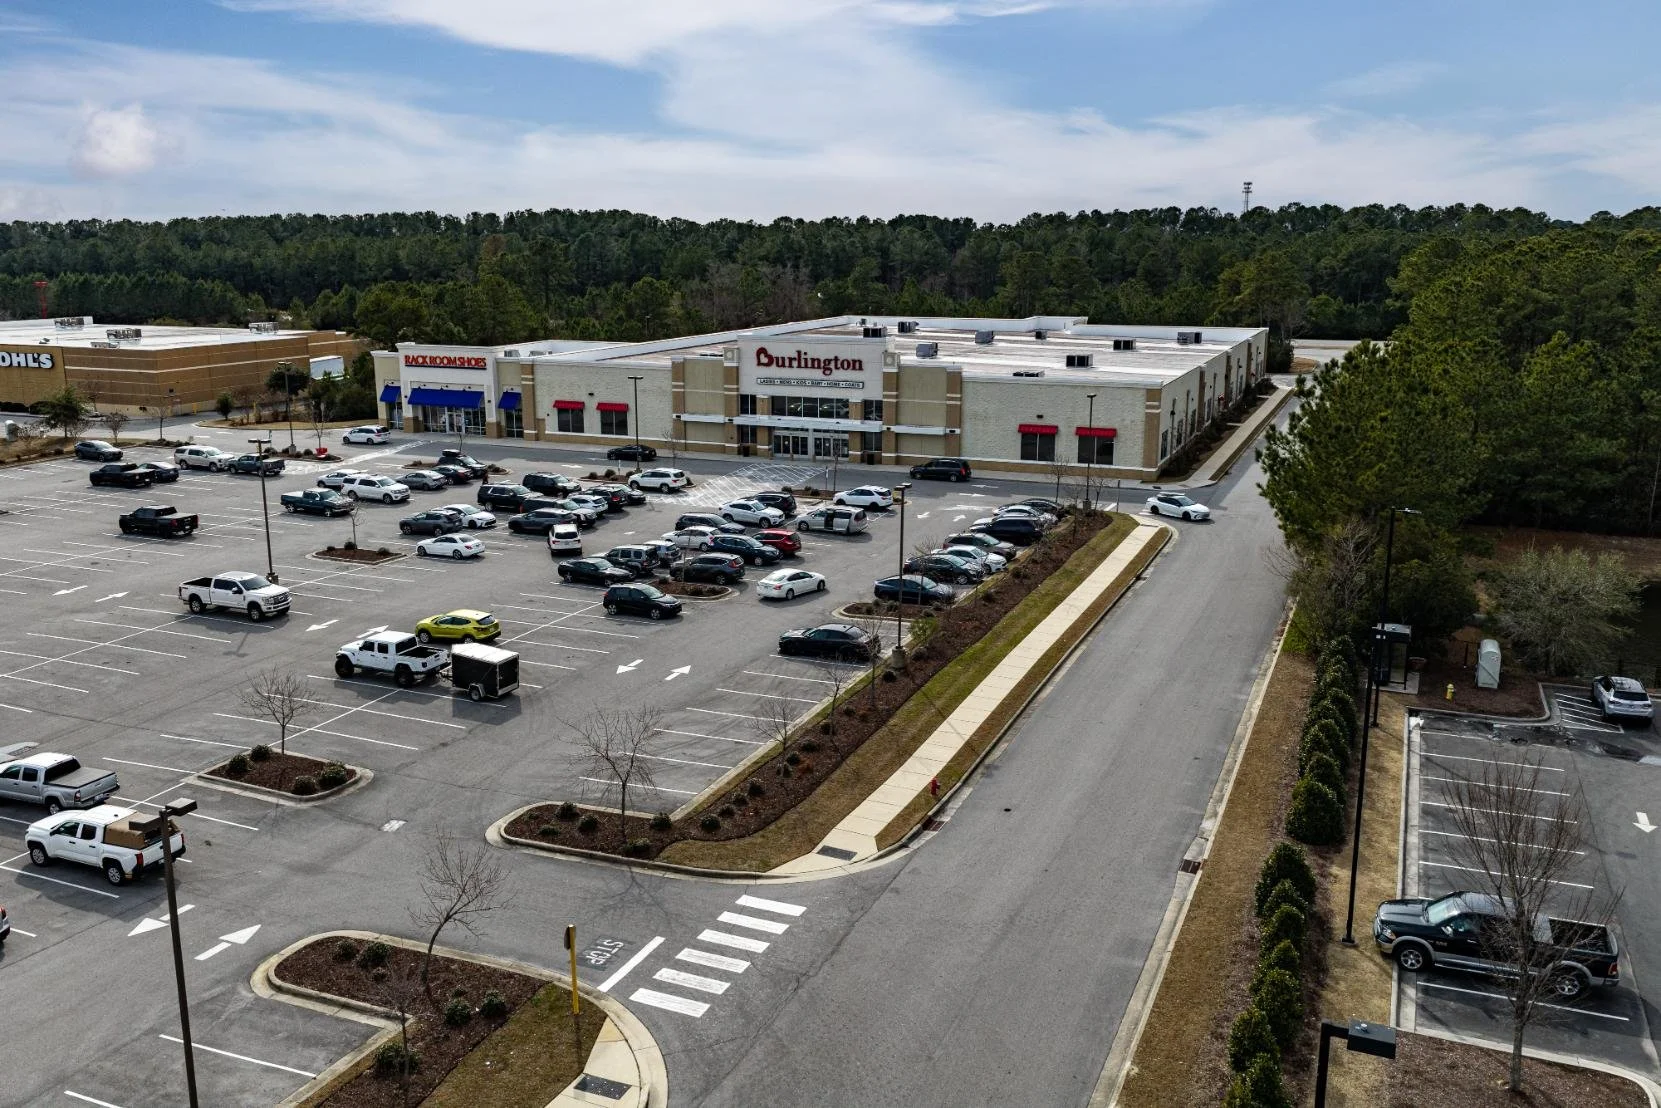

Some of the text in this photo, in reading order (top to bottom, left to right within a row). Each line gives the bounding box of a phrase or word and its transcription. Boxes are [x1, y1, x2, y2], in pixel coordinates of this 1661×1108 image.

[405, 355, 487, 367] RACK ROOM SHOES
[756, 347, 864, 376] Burlington
[585, 939, 624, 964] STOP
